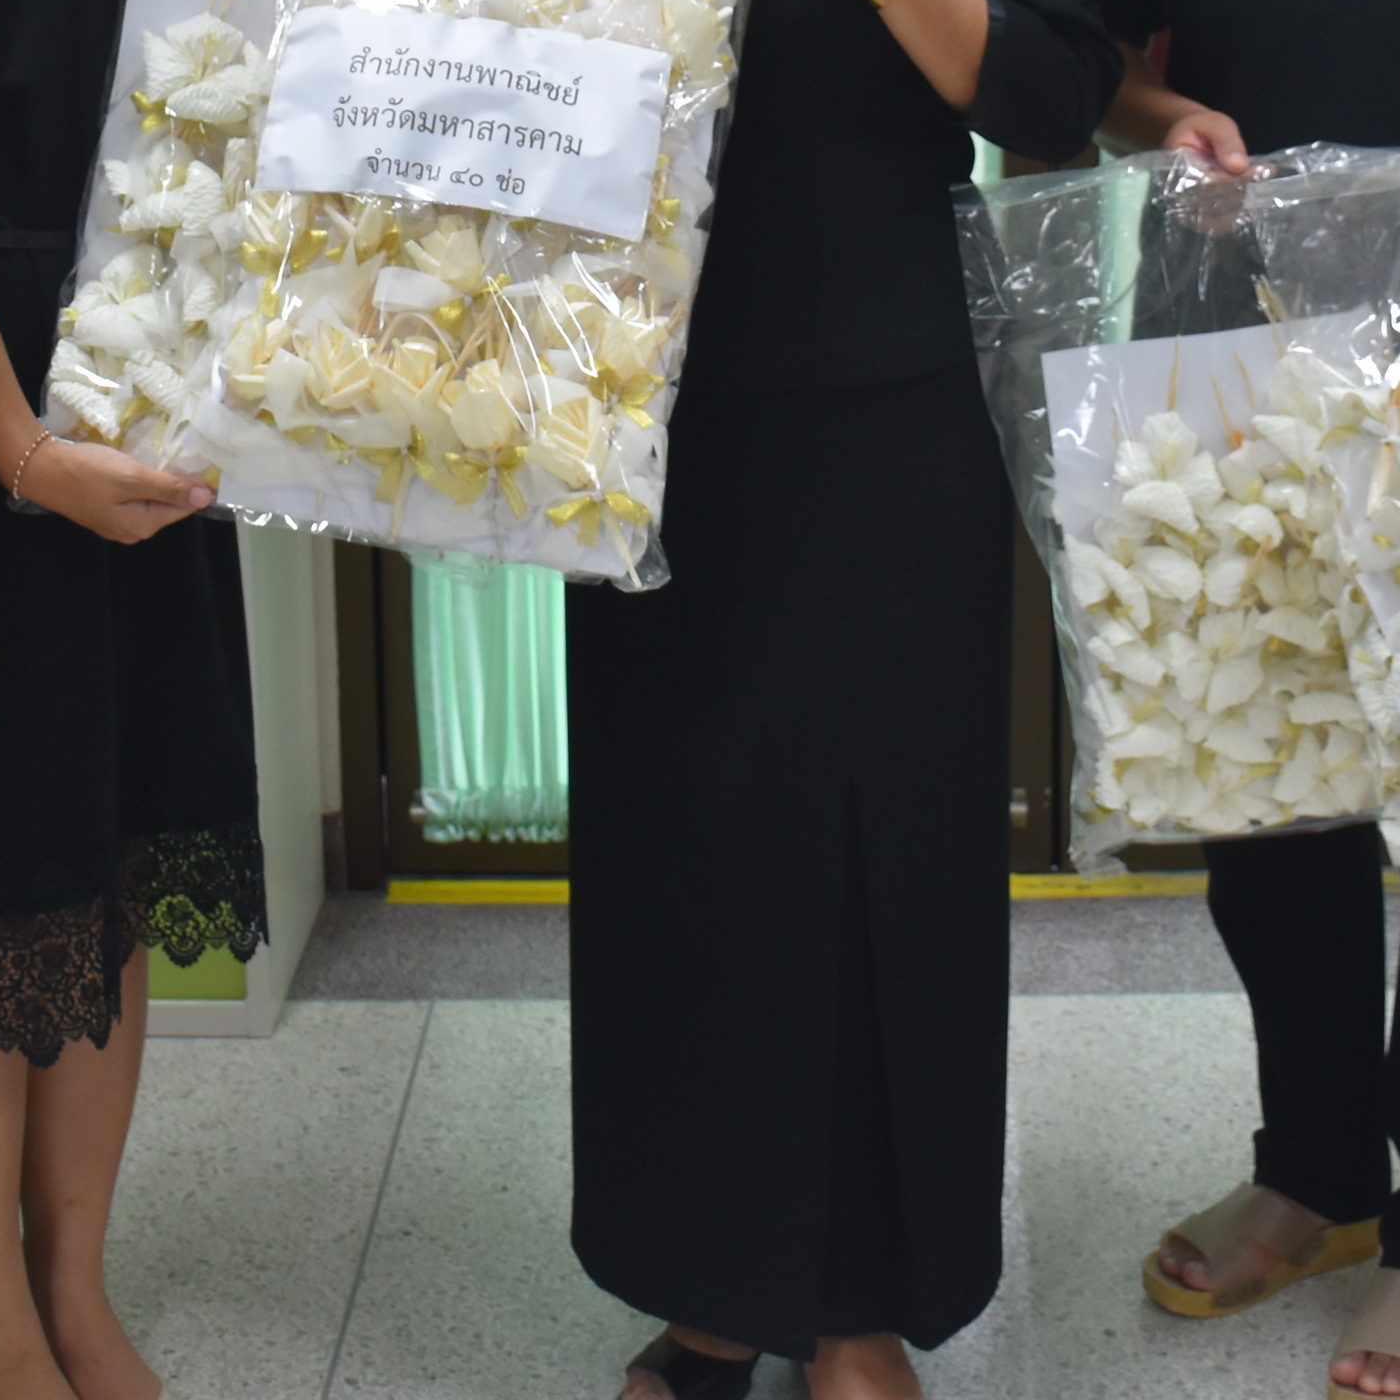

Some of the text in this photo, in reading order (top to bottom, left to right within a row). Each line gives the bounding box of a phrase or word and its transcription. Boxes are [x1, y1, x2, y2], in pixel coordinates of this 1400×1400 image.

[348, 46, 582, 107] สำนักงานพาณิชย์
[331, 95, 585, 157] จังหวัดมหาสารคาม
[366, 148, 442, 183] จำนวน
[495, 169, 527, 196] ช่อ
